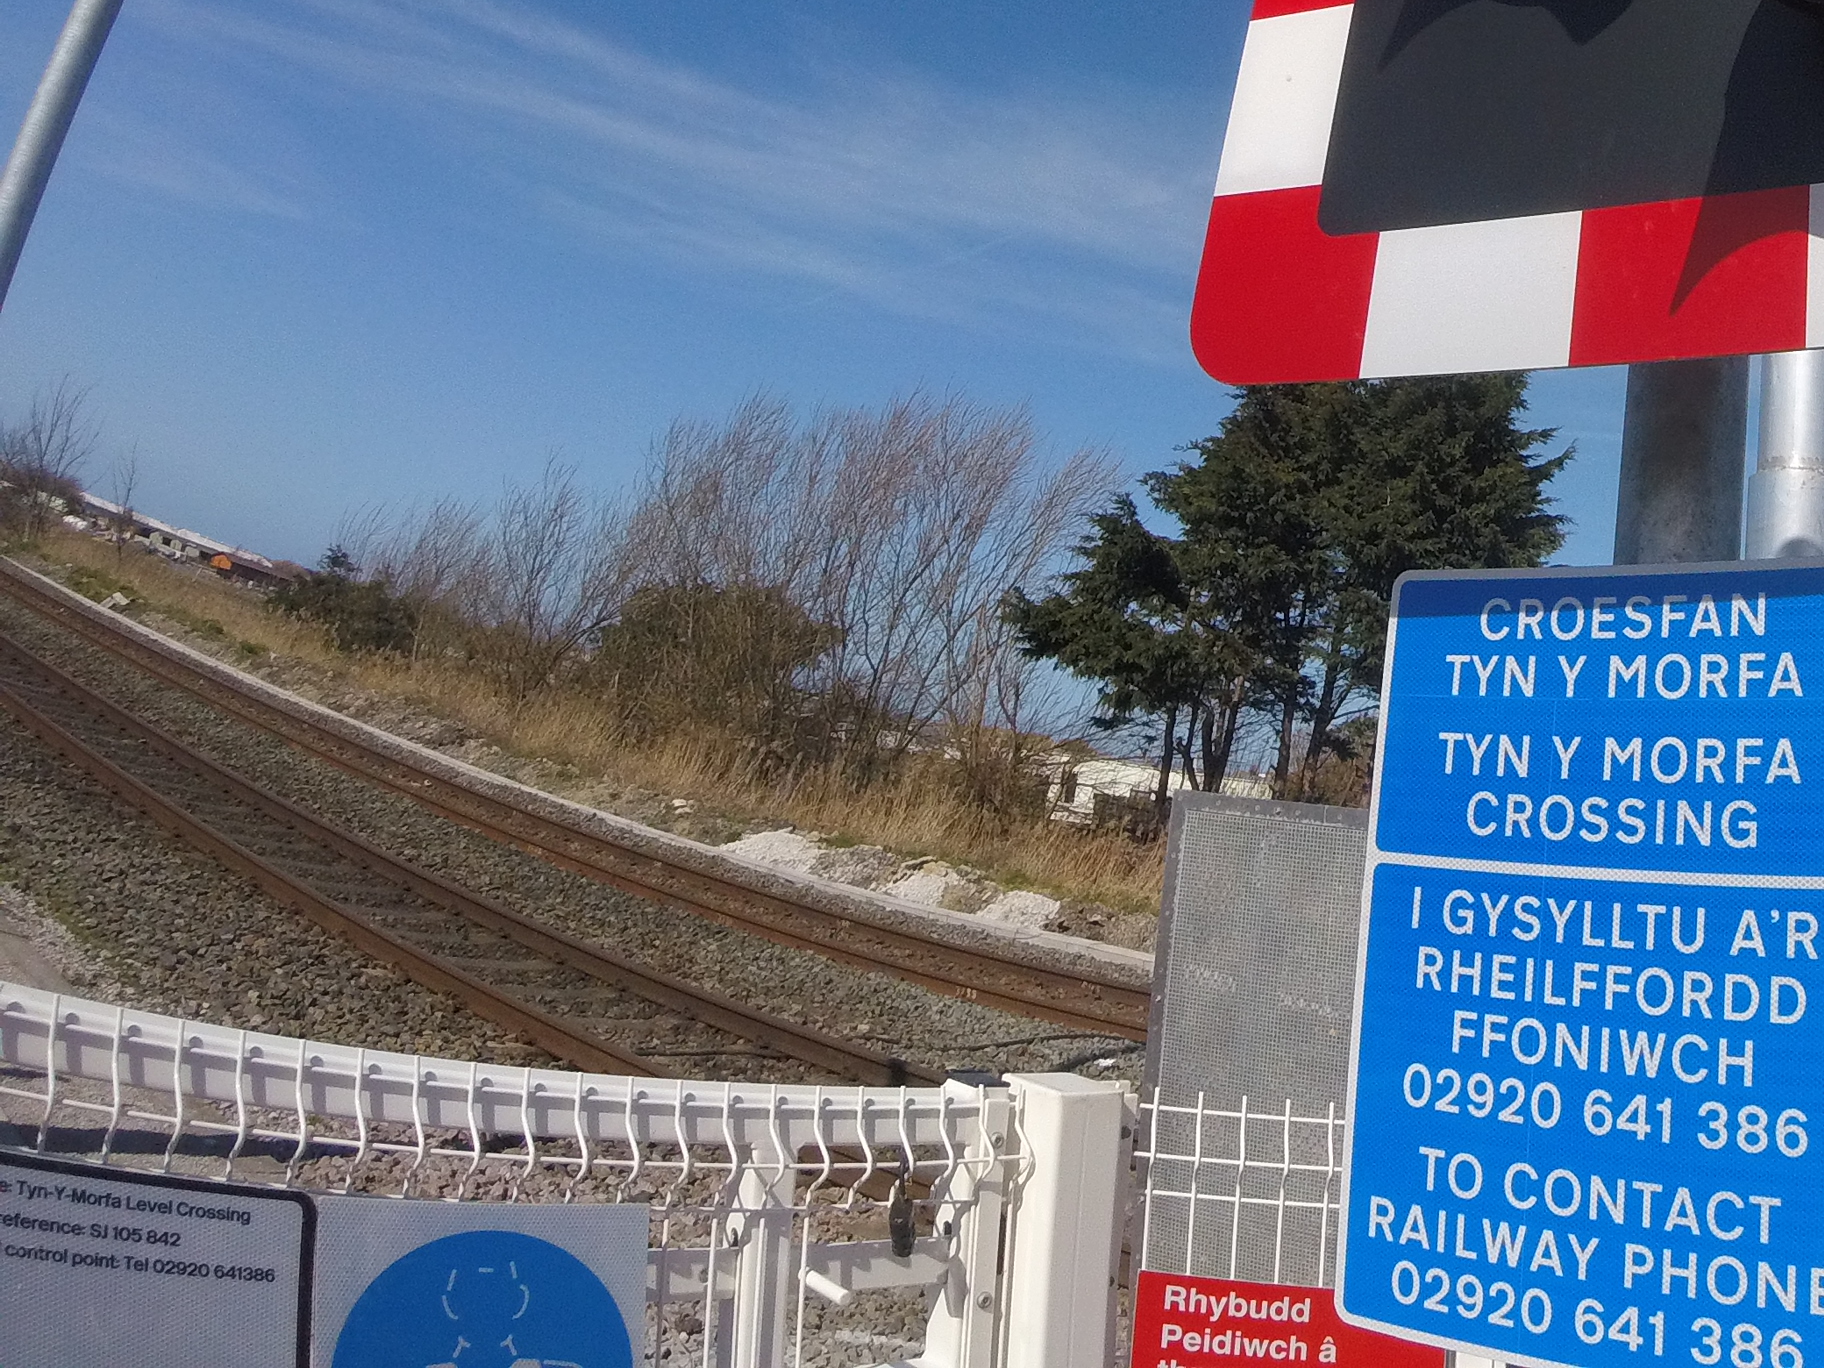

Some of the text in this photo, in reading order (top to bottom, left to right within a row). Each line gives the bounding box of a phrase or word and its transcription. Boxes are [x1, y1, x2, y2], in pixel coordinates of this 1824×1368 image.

[1480, 593, 1767, 641] CROESFAN
[1445, 651, 1804, 700] TYN Y MORFA
[1438, 732, 1802, 784] TYN Y MORFA
[1466, 790, 1758, 849] CROSSING
[1411, 886, 1819, 960] I GYSYLLTU A'R
[1415, 945, 1807, 1025] RHEILFFORDD
[1451, 1009, 1754, 1087] FFONIWCH
[1403, 1062, 1809, 1158] 02920 641 386
[17, 1180, 121, 1209] Tyn-Y-Morfa
[126, 1195, 173, 1215] Level
[176, 1202, 251, 1226] Crossing
[1418, 1146, 1782, 1244] TO CONTACT
[90, 1223, 109, 1239] SJ
[113, 1226, 143, 1243] 105
[146, 1230, 182, 1247] 842
[1368, 1195, 1600, 1281] RAILWAY
[4, 1244, 68, 1264] control
[124, 1255, 149, 1272] Tel
[153, 1259, 210, 1278] 02920
[214, 1264, 276, 1283] 641386
[1163, 1284, 1311, 1322] Rhybudd
[1391, 1260, 1804, 1368] 02920 641 386
[1160, 1323, 1337, 1363] Peidiwch â
